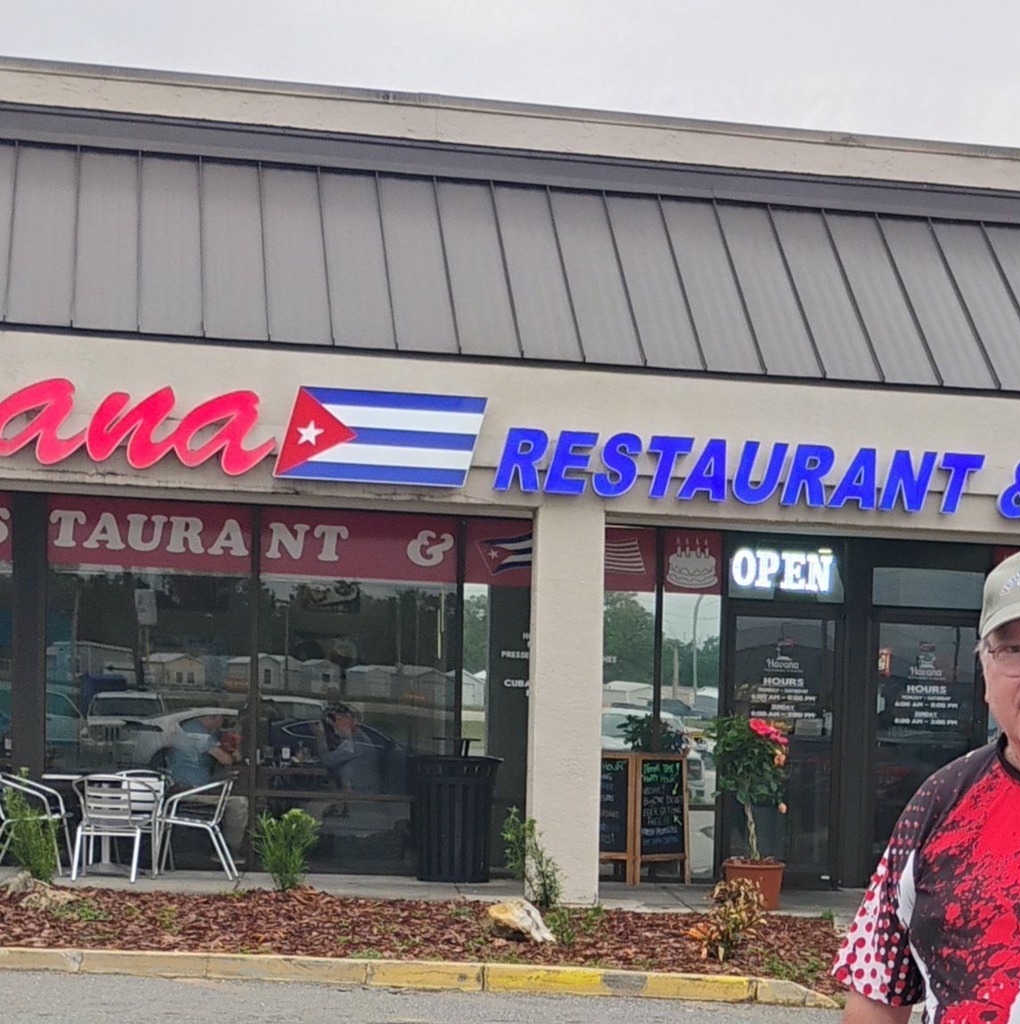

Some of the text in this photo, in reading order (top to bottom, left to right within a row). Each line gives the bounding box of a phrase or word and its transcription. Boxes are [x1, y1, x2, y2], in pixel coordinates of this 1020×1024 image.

[0, 378, 277, 476] ana
[493, 427, 986, 514] RESTAURANT
[407, 530, 454, 567] &
[731, 547, 834, 592] OPEN
[763, 677, 804, 687] HOURS
[907, 685, 947, 695] HOURS
